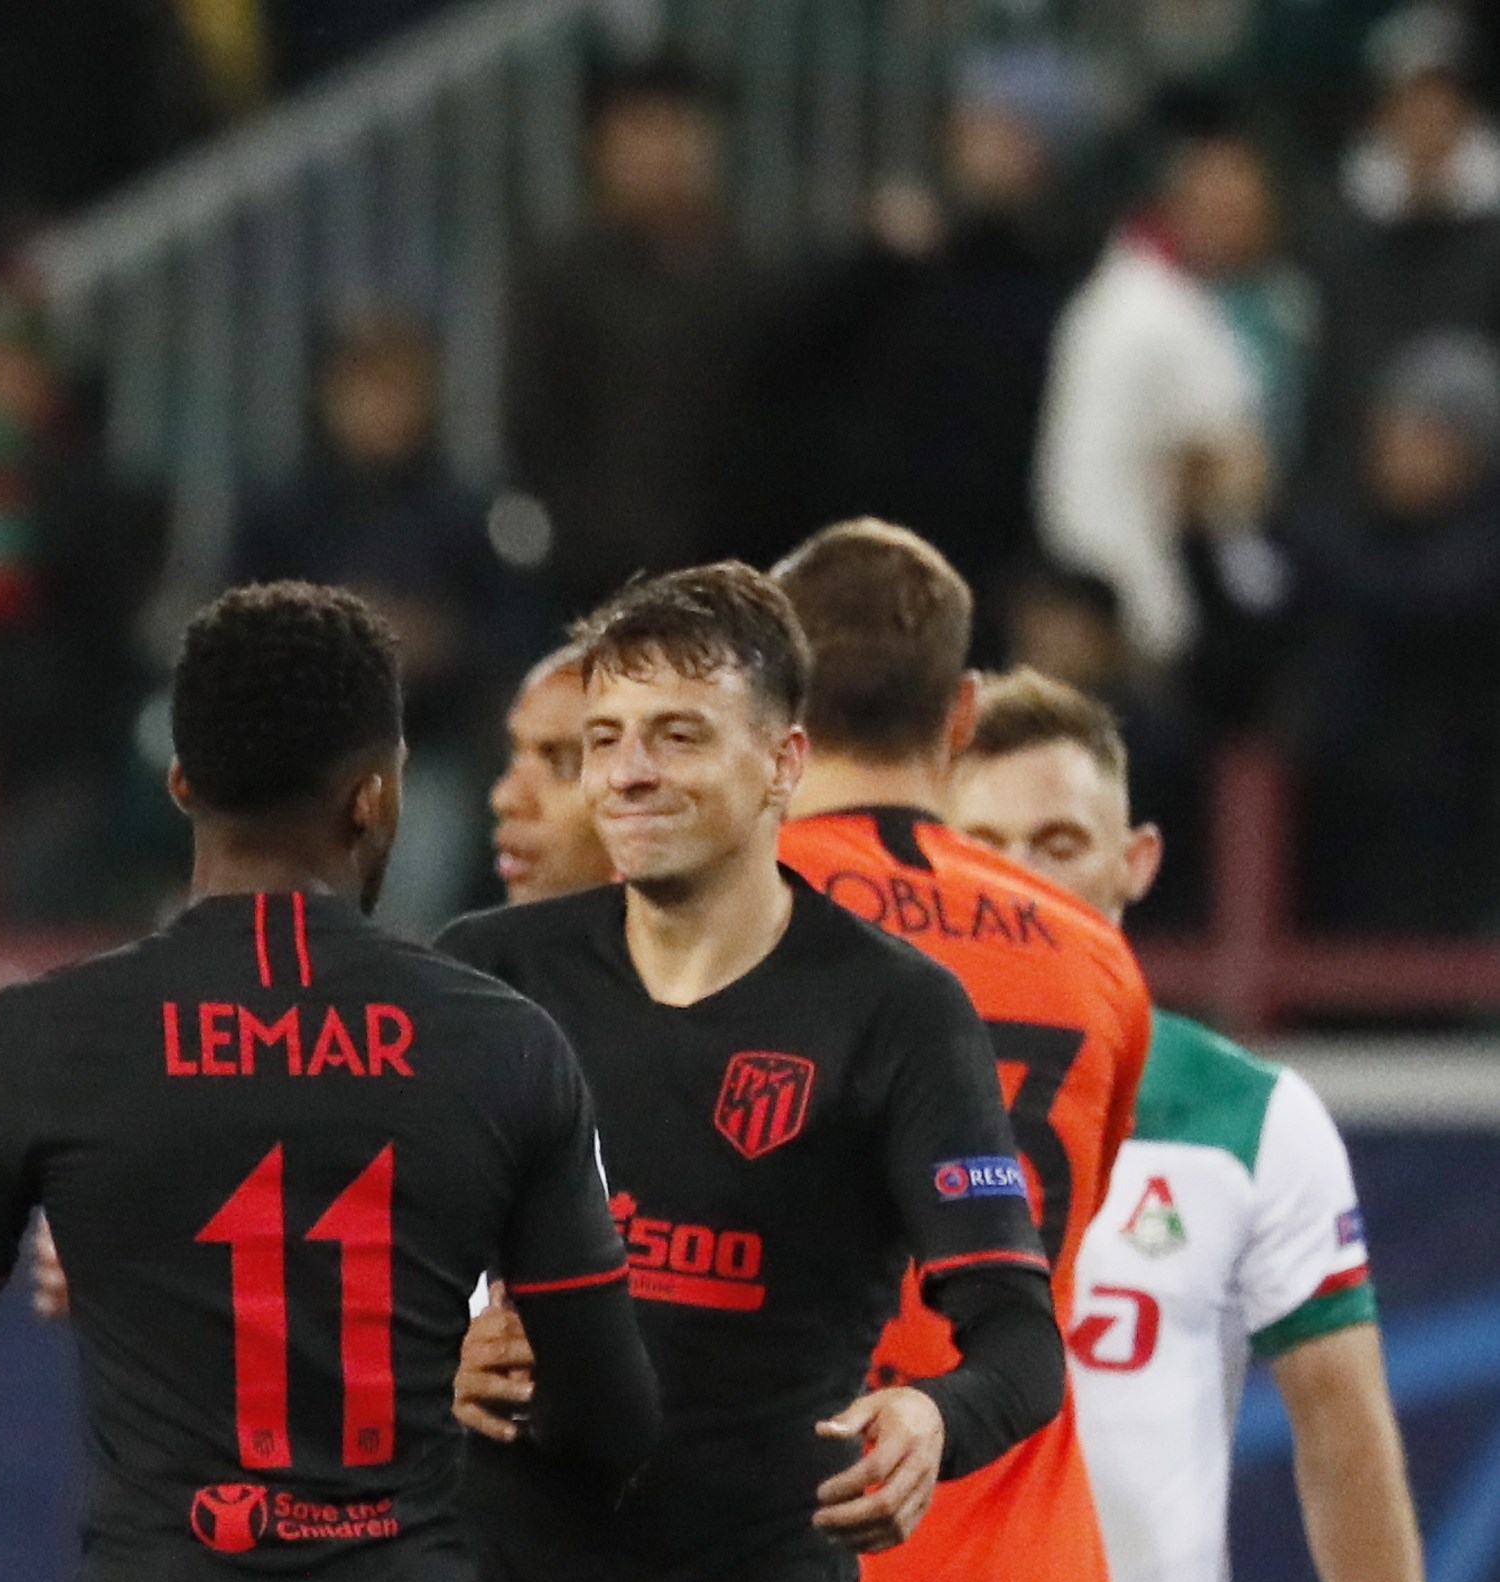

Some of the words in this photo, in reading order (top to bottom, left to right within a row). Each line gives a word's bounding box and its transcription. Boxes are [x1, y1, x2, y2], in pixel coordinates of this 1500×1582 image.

[825, 870, 1056, 949] OBLAK
[162, 1000, 416, 1078] LEMAR
[615, 1215, 763, 1281] 500
[193, 1140, 395, 1470] 11
[274, 1491, 338, 1522] Save
[346, 1498, 393, 1521] the
[276, 1517, 399, 1541] Children
